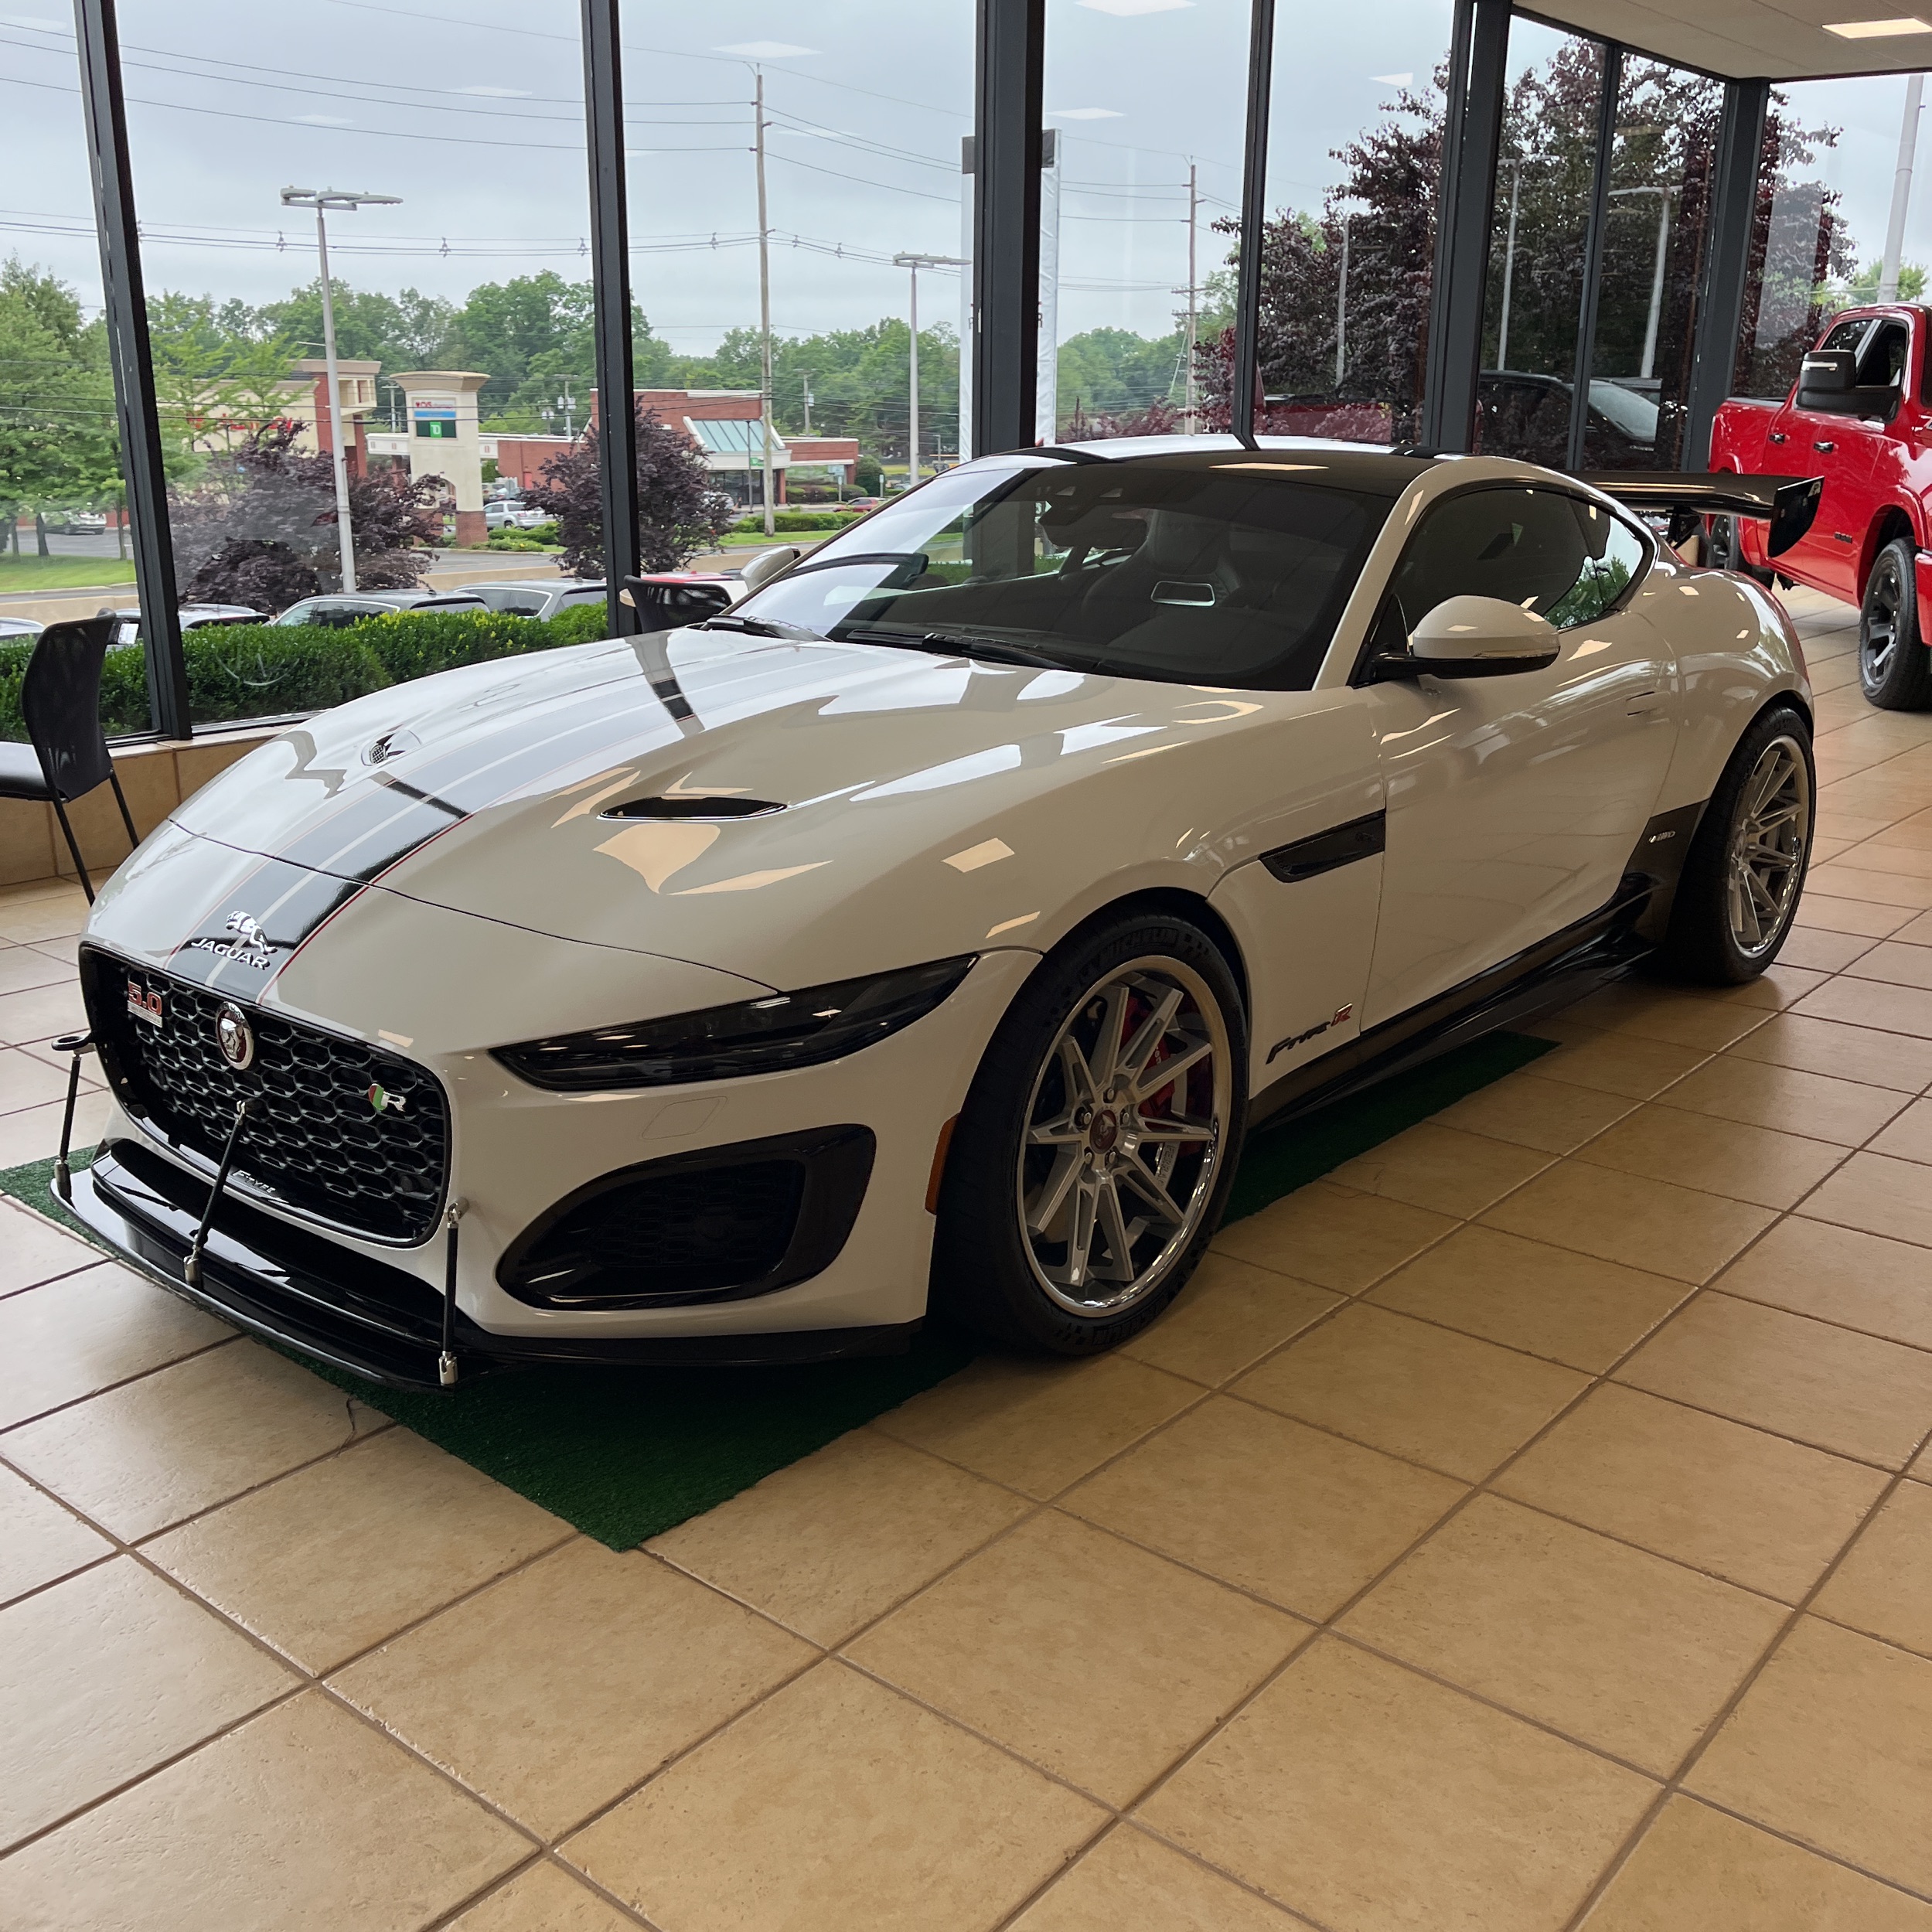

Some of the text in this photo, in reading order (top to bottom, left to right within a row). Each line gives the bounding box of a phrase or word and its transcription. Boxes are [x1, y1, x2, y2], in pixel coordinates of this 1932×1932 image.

[431, 424, 441, 434] TD
[191, 938, 268, 969] JAGUAR
[128, 981, 162, 1016] 5.0
[1331, 1002, 1352, 1027] R
[380, 1090, 407, 1113] R
